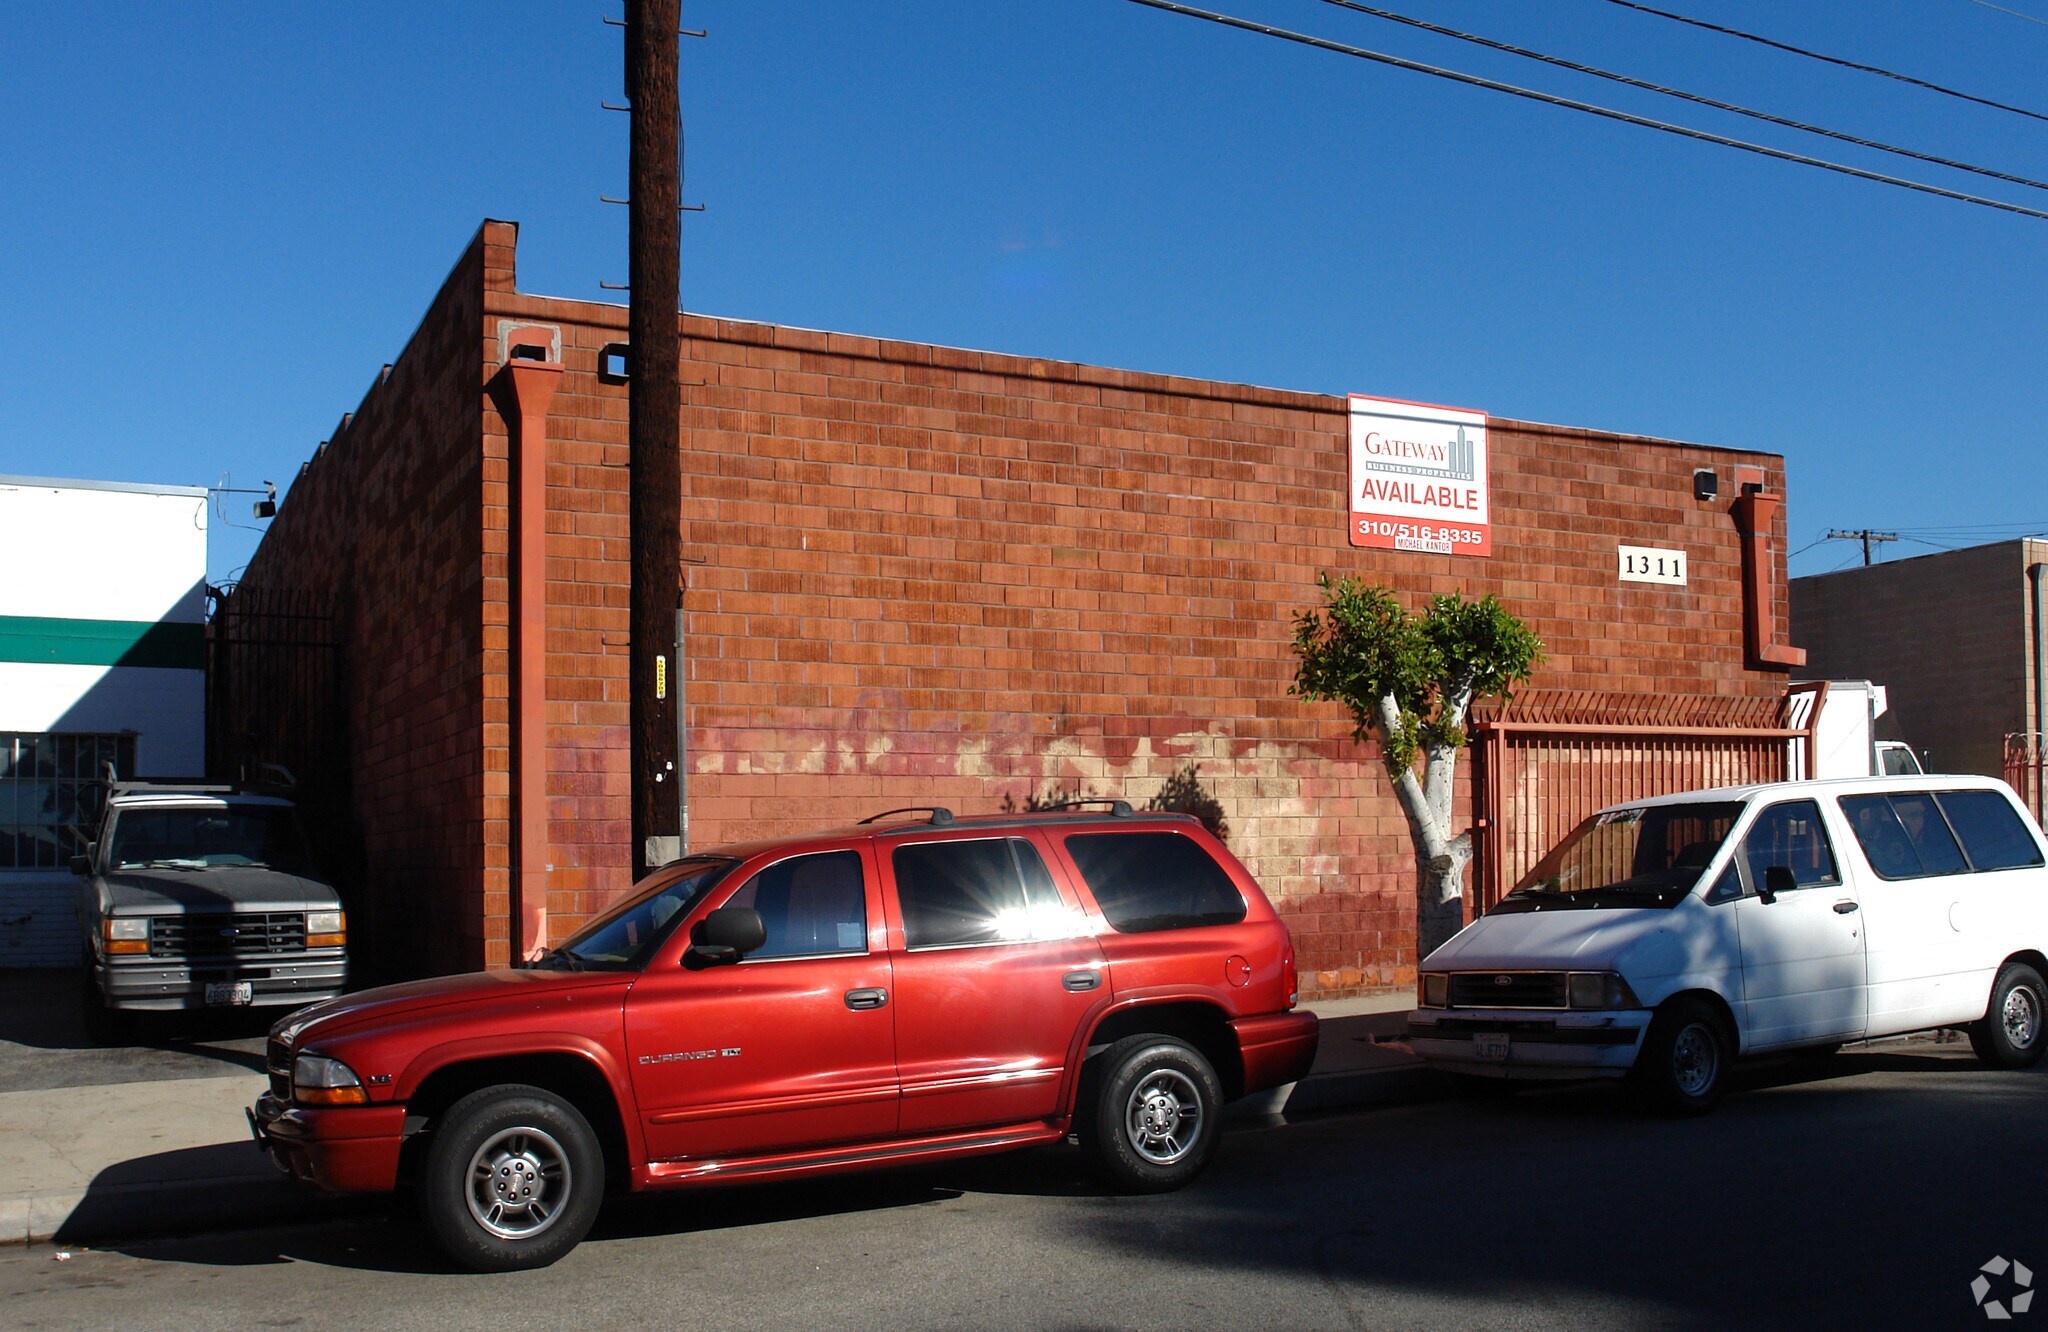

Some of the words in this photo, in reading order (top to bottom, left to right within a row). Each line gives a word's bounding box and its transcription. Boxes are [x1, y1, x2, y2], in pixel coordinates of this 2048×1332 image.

[1365, 432, 1446, 462] GATEWAY
[1367, 462, 1413, 474] BUSINESS
[1416, 466, 1472, 481] PROPERTIES
[1362, 478, 1478, 511] AVAILABLE
[1358, 520, 1482, 545] 310/516-8335
[1397, 538, 1423, 550] MICHAEL
[1426, 539, 1450, 552] KANTOR
[1626, 554, 1681, 578] 1311
[639, 1049, 717, 1065] DURANGO
